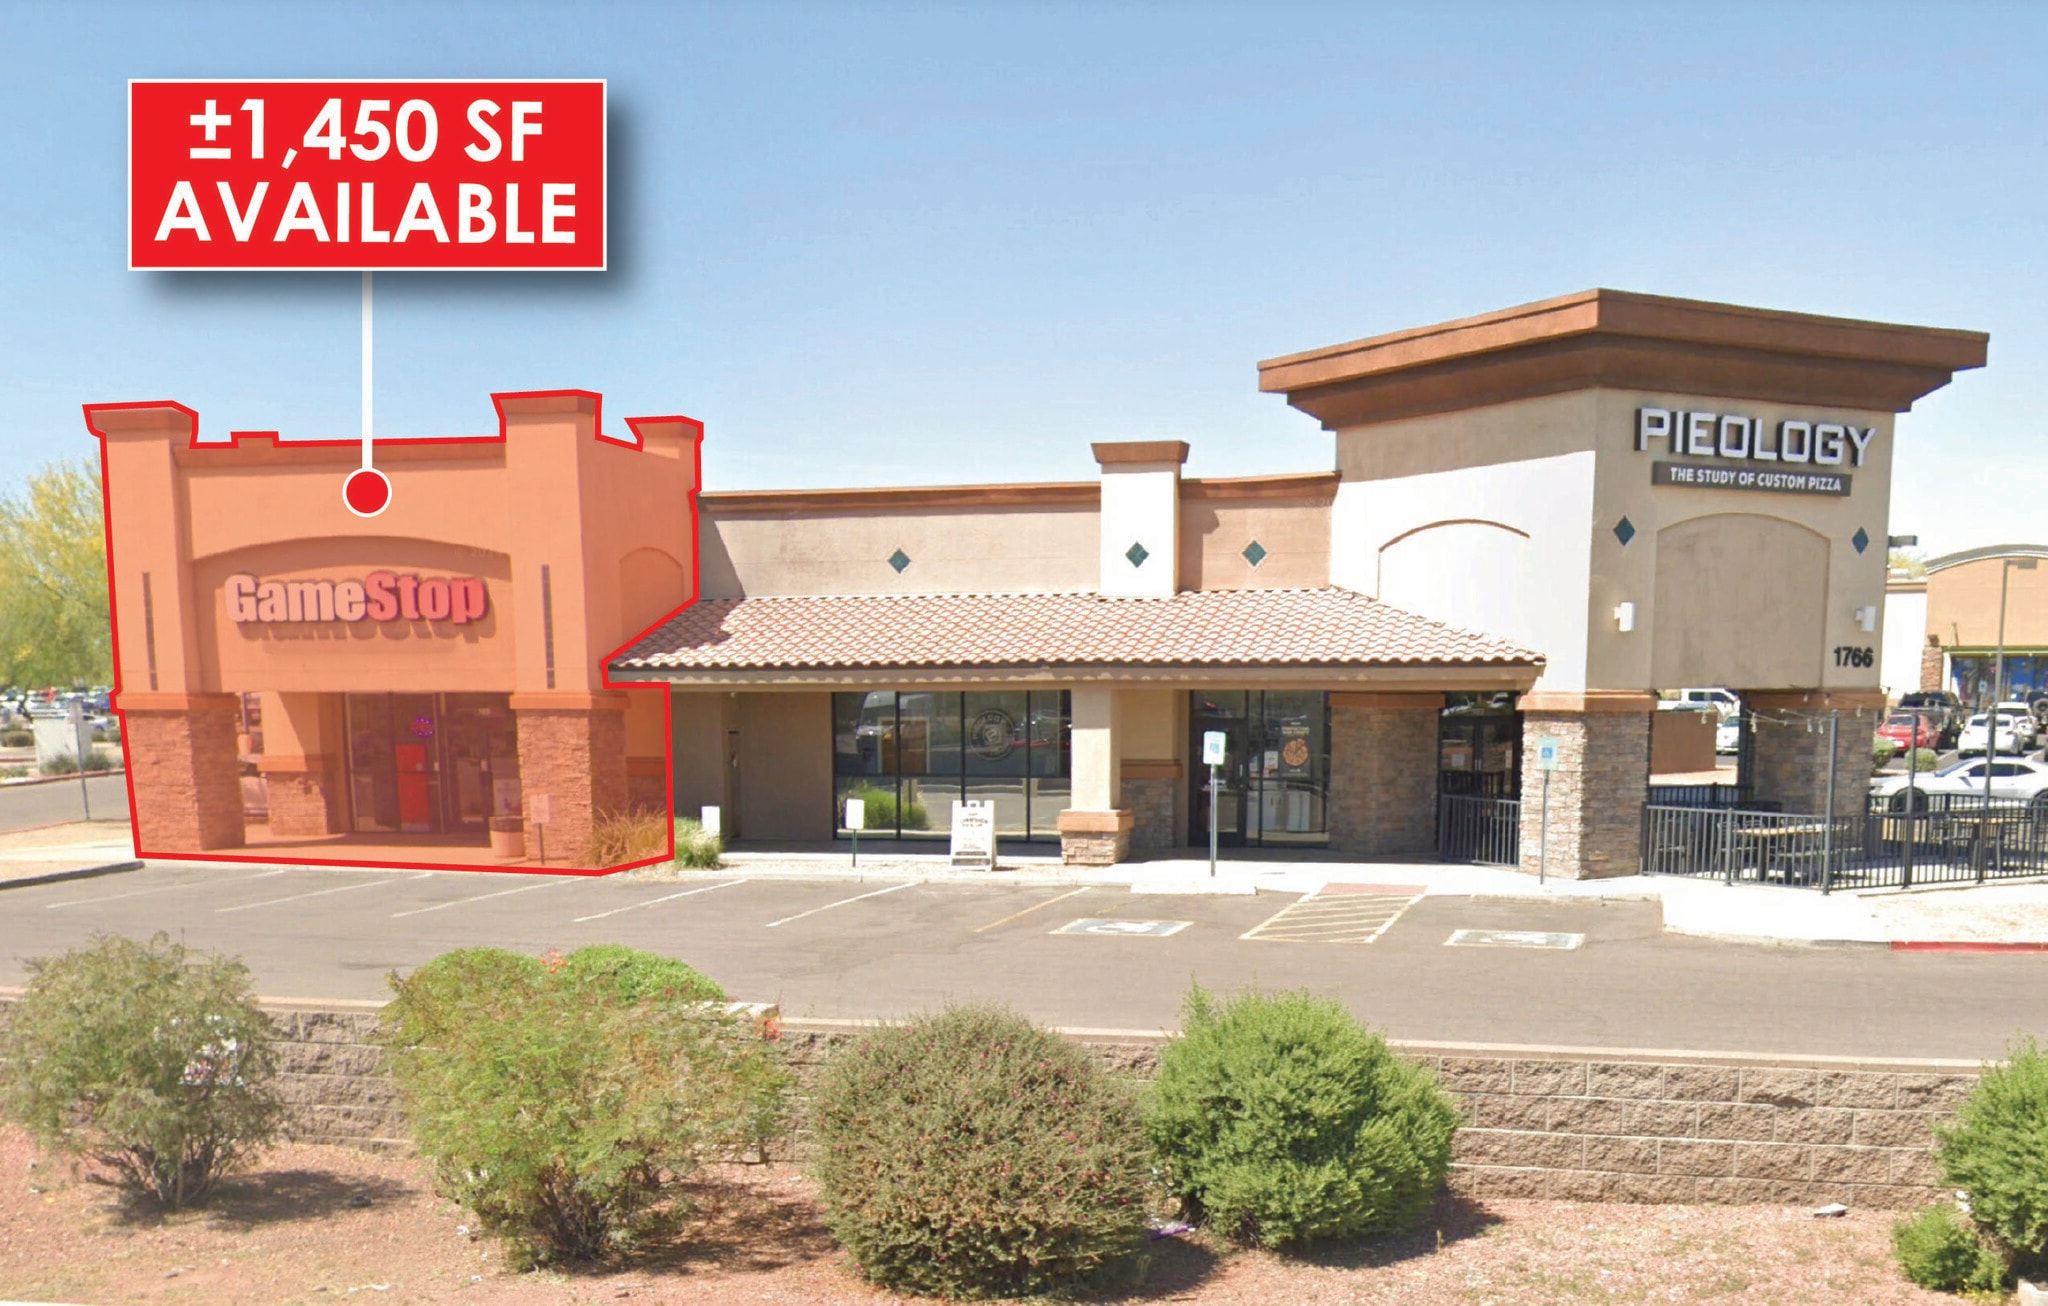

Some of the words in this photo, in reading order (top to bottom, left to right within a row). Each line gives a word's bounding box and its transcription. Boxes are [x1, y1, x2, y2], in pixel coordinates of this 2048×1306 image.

[1636, 407, 1876, 468] PIEOLOGY
[1670, 467, 1695, 482] THE
[1696, 470, 1736, 485] STUDY
[1738, 474, 1755, 487] OF
[1757, 475, 1806, 490] CUSTOM
[1808, 477, 1842, 492] PIZZA
[224, 570, 486, 624] GameStop
[1833, 646, 1874, 668] 1766
